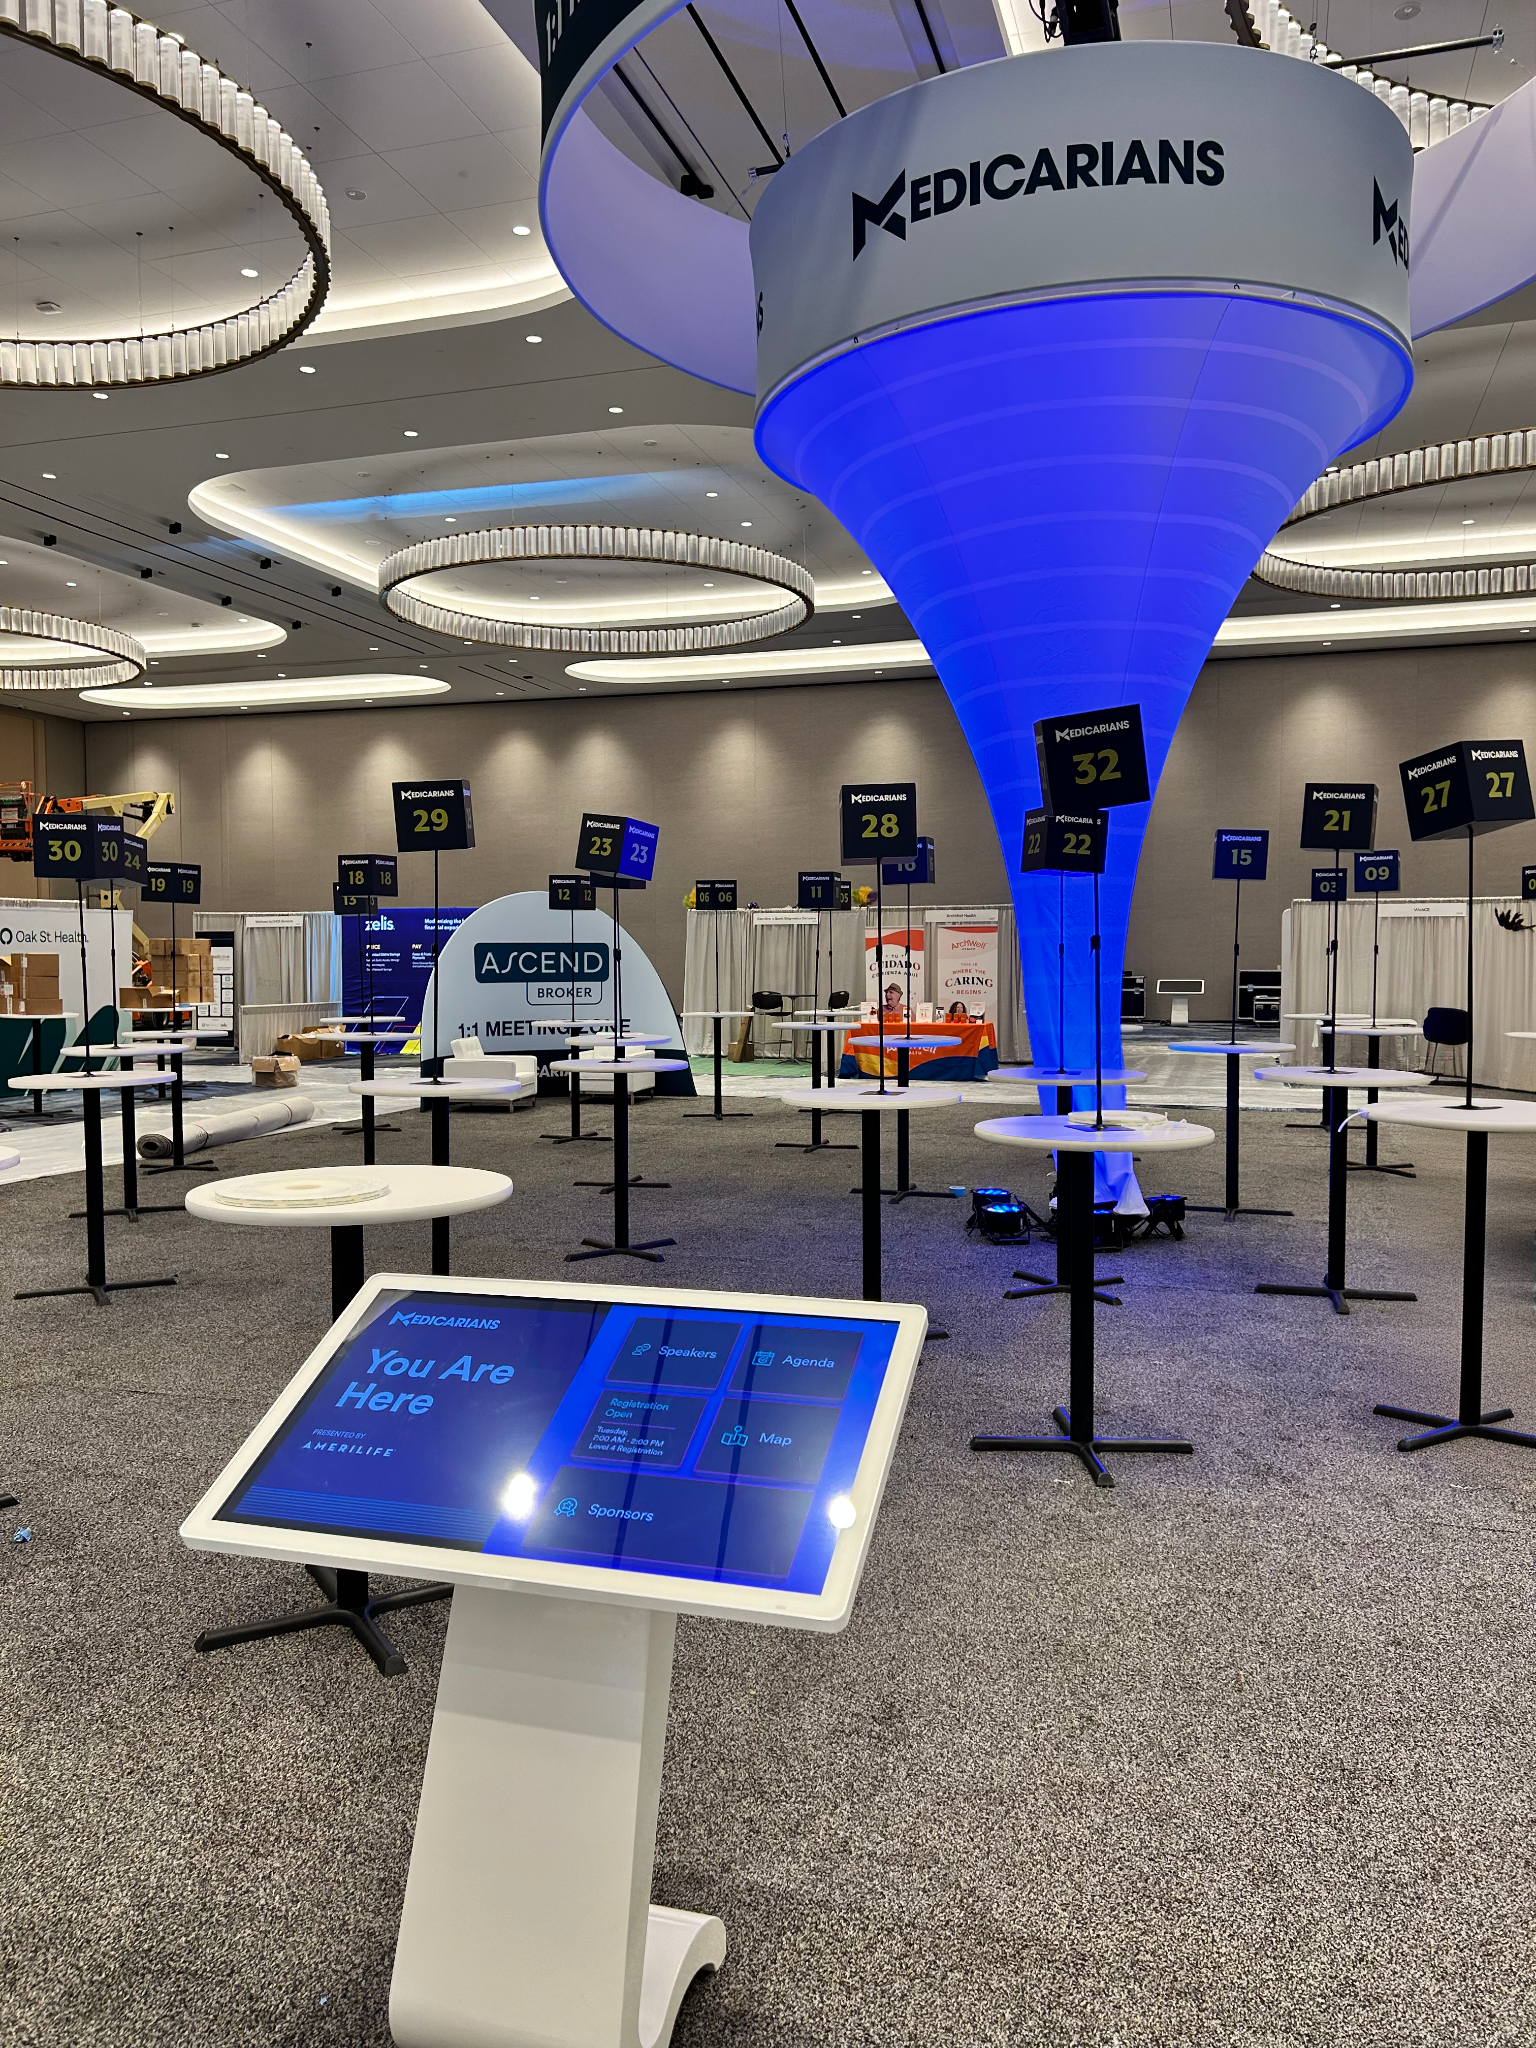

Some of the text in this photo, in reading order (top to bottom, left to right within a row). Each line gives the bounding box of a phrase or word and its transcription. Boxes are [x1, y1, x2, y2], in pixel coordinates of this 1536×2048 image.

[853, 140, 1225, 262] MEDICARIANS
[1055, 720, 1130, 743] MEDICARIANS
[1471, 749, 1519, 761] MEDICARIANS
[1072, 749, 1122, 785] 32
[1408, 755, 1457, 780] MEDICARIANS
[1485, 772, 1515, 798] 27
[401, 790, 455, 800] MEDICARIANS
[851, 793, 907, 804] MEDICARIANS
[1313, 791, 1366, 800] MEDICARIANS
[1421, 780, 1451, 814] 27
[40, 821, 87, 831] MEDICARIANS
[413, 808, 449, 832] 29
[586, 819, 621, 830] MEDICARIANS
[861, 813, 899, 838] 28
[1055, 814, 1101, 825] MEDICARIAS
[1323, 809, 1350, 831] 21
[97, 823, 121, 832] MEDICARIANS
[628, 825, 655, 839] MEDICARIANS
[1027, 833, 1041, 854] 22
[1062, 833, 1092, 855] 22
[1222, 834, 1262, 842] MEDICARIANS
[48, 840, 82, 862] 30
[101, 841, 119, 862] 30
[589, 836, 613, 856] 23
[124, 851, 141, 870] 24
[630, 843, 649, 864] 23
[1231, 849, 1252, 866] 15
[348, 870, 365, 885] 18
[380, 871, 392, 885] 18
[1364, 866, 1390, 881] 09
[150, 878, 166, 892] 19
[182, 880, 194, 893] 19
[810, 886, 822, 898] 11
[557, 888, 571, 901] 12
[584, 889, 592, 901] 12
[699, 891, 710, 903] 06
[718, 892, 733, 903] 06
[15, 930, 37, 943] Oak
[481, 951, 603, 974] ASCEND
[944, 976, 993, 988] CARING
[537, 987, 593, 999] BROKER
[458, 1022, 479, 1038] 1:1
[388, 1310, 500, 1330] MEDICARIANS
[658, 1345, 718, 1359] Speakers
[366, 1348, 515, 1384] You Are
[782, 1355, 835, 1368] Agenda
[335, 1381, 435, 1415] Here
[610, 1397, 669, 1411] Registration
[605, 1408, 633, 1419] Open
[312, 1428, 355, 1439] PRESENTED
[597, 1426, 628, 1436] Tuesday,
[592, 1434, 610, 1442] 7:00
[630, 1438, 648, 1446] 2:00
[650, 1439, 664, 1447] PM
[759, 1432, 793, 1447] Map
[302, 1440, 394, 1457] AMERILIFE
[588, 1442, 609, 1451] Level
[616, 1444, 663, 1456] Registration
[588, 1503, 654, 1523] Sponsors
